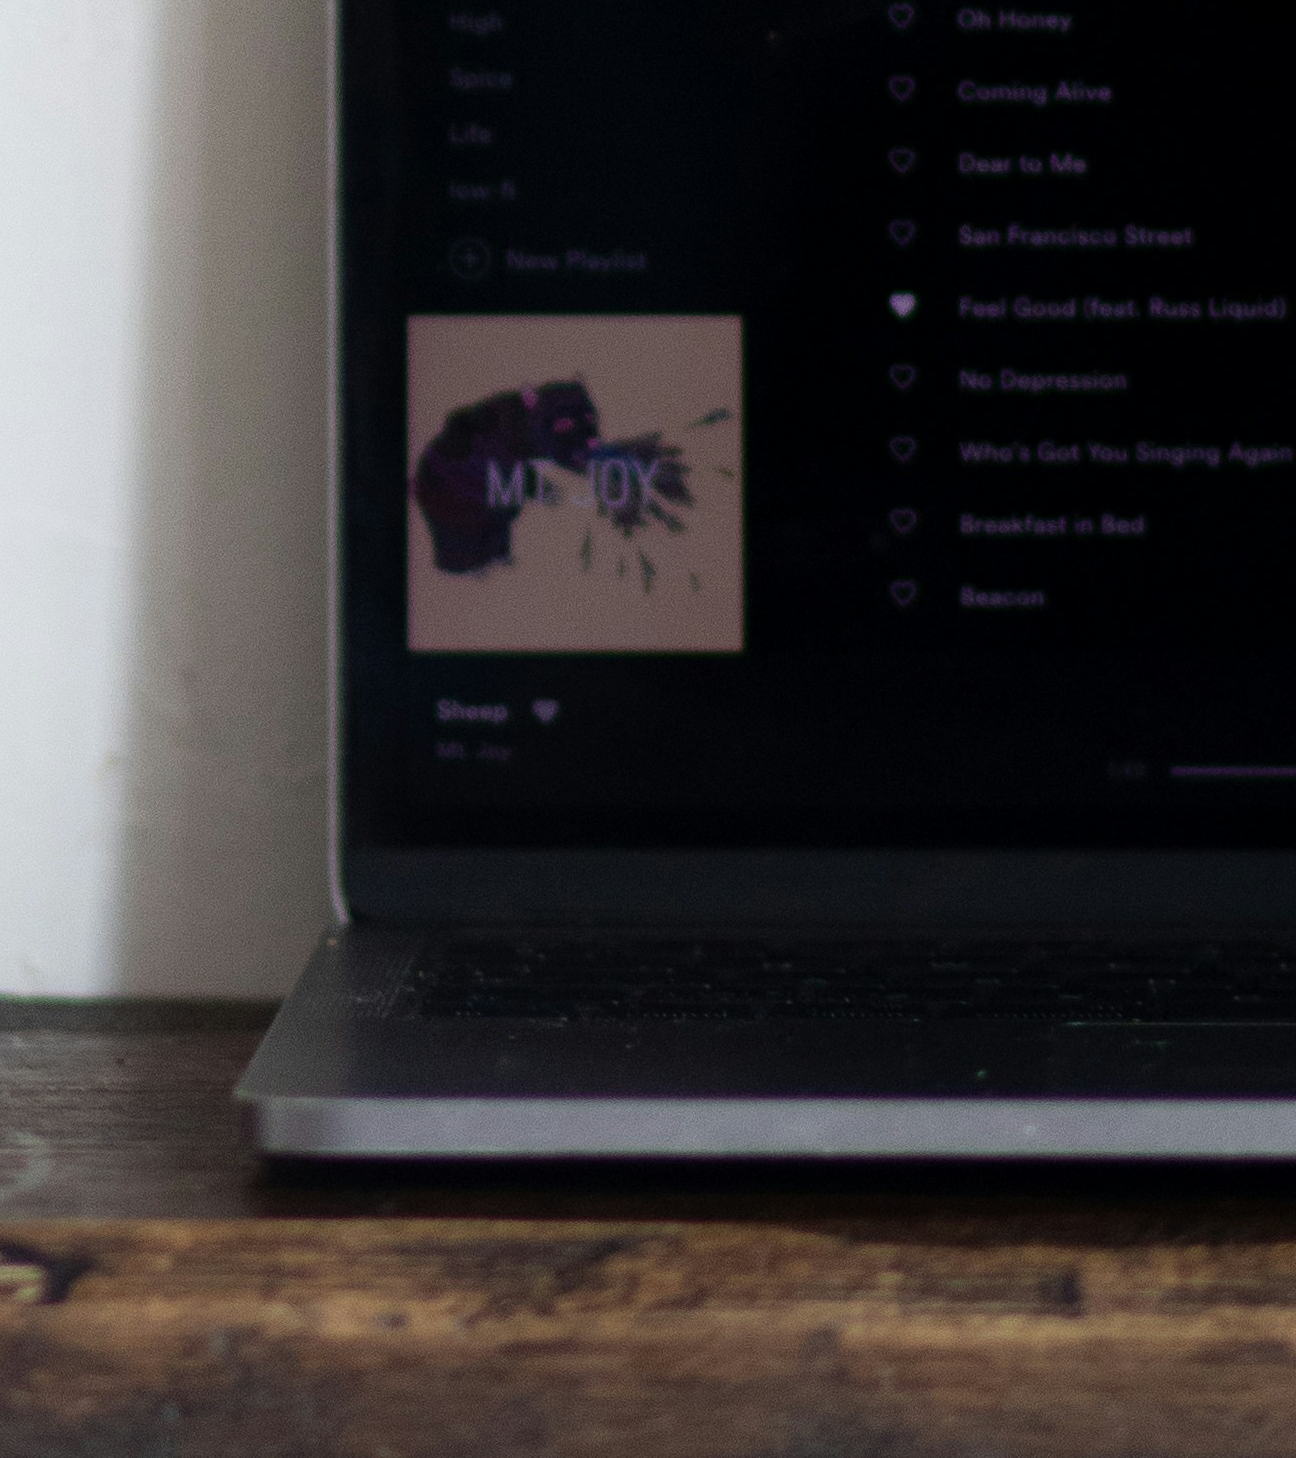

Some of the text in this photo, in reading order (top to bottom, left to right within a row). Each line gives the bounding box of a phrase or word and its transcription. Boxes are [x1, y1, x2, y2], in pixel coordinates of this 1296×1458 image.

[956, 7, 1073, 34] Oh Honey
[956, 78, 1114, 108] Coming Alive
[957, 151, 1088, 175] Dear to Me
[957, 221, 1195, 248] San Francisco Street
[505, 246, 649, 272] New Playlist
[957, 293, 1288, 322] Feel Good (feat. Russ Liquid)
[958, 367, 1129, 395] No Depression
[958, 438, 1295, 469] Who's Got You Singing Again
[959, 511, 1147, 536] Breakfast in Bed
[959, 585, 1046, 608] Beacon
[435, 697, 511, 725] Sheep
